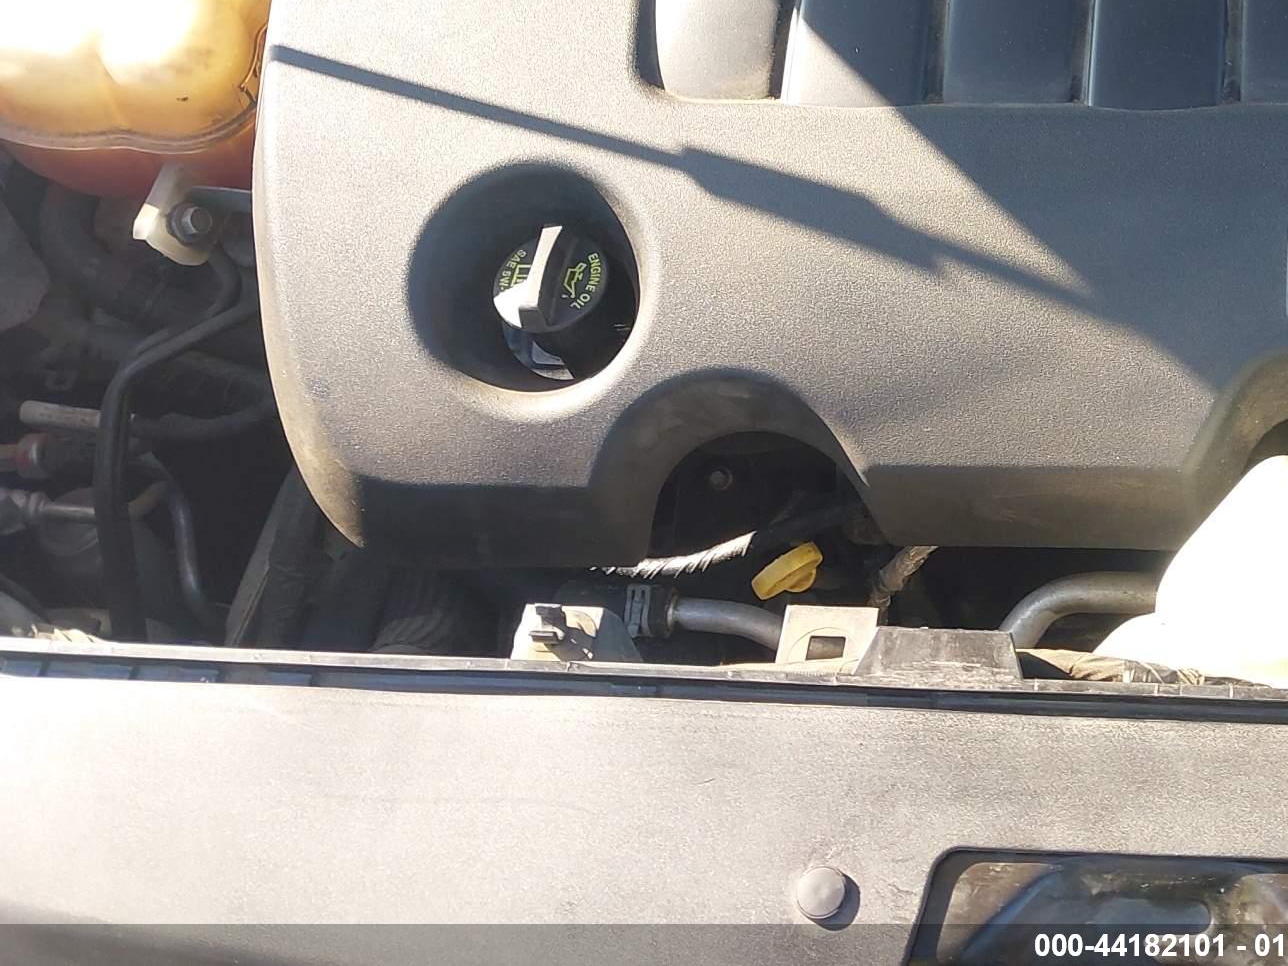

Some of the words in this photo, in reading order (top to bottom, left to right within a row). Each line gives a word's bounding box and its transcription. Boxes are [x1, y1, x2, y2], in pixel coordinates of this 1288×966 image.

[506, 249, 527, 269] SAE
[585, 253, 602, 292] ENGINE
[570, 293, 591, 309] OIL
